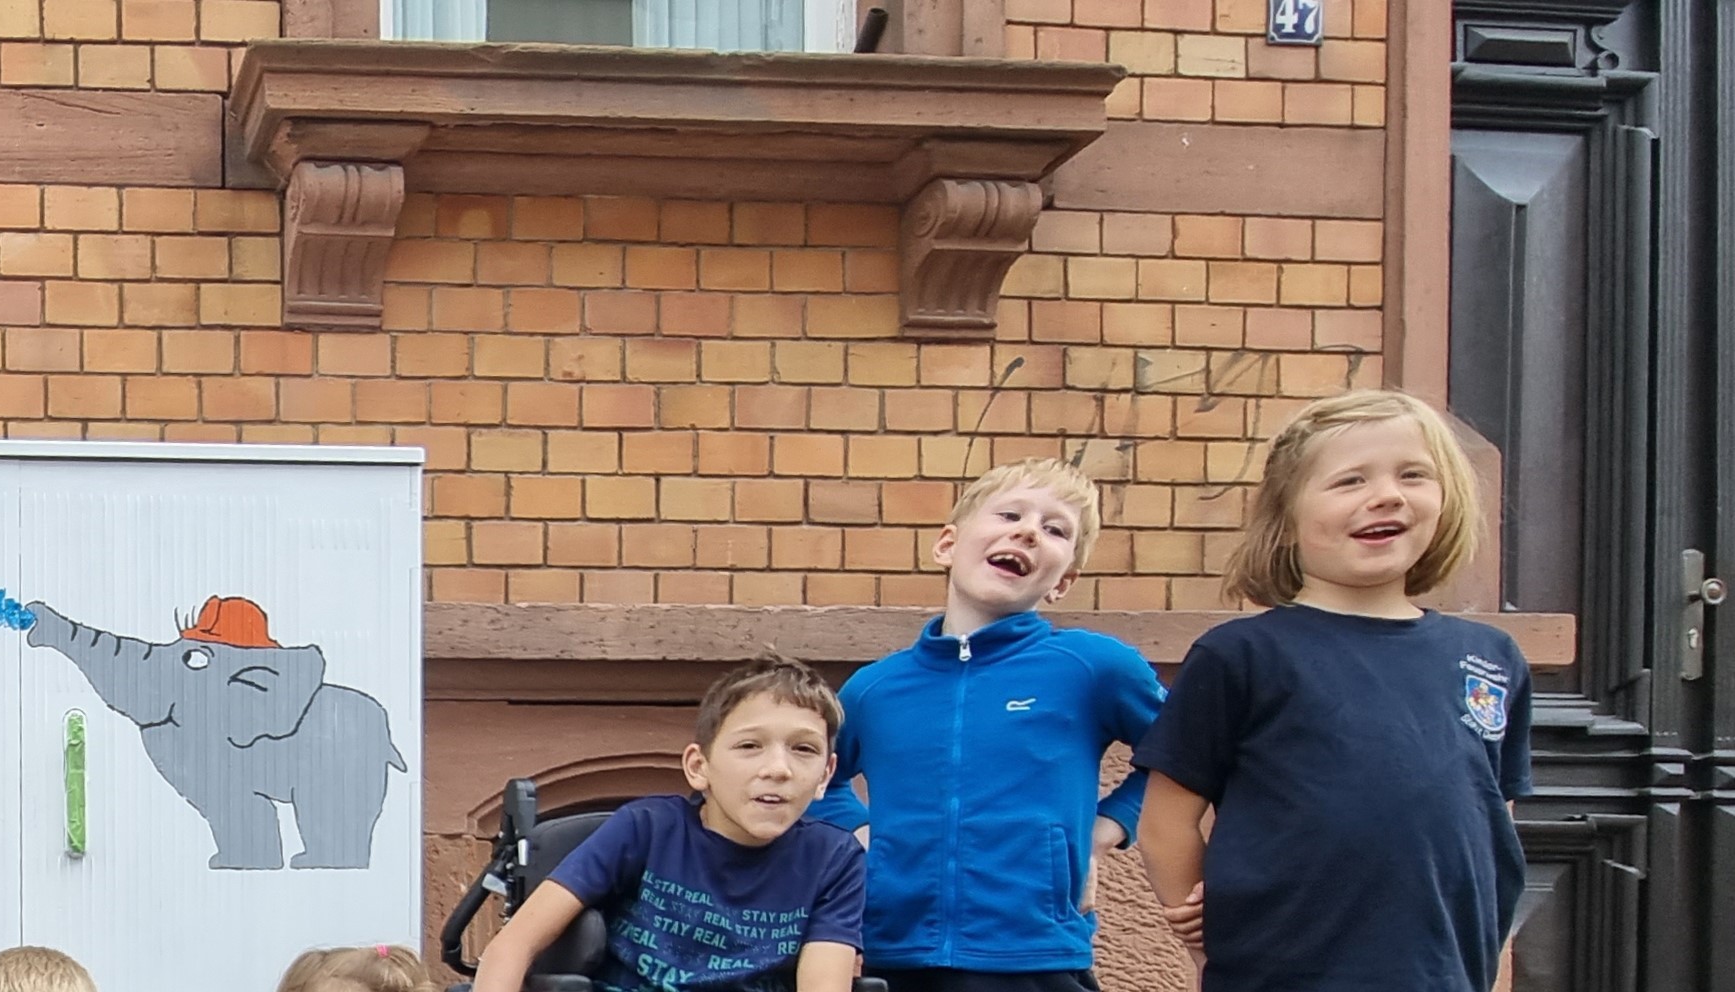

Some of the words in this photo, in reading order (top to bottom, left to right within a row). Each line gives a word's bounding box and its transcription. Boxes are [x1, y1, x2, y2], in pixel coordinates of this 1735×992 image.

[1275, 0, 1319, 34] 47
[641, 888, 666, 911] REAL
[704, 911, 733, 931] REAL
[735, 923, 766, 940] STAY
[771, 923, 802, 940] REAL
[654, 879, 684, 897] STAY
[684, 890, 714, 907] REAL
[742, 909, 776, 924] STAY
[779, 906, 809, 924] REAL
[653, 915, 691, 937] STAY
[692, 926, 727, 950] REAL
[777, 941, 801, 956] RE
[637, 953, 694, 985] STAY
[708, 955, 754, 970] REAL
